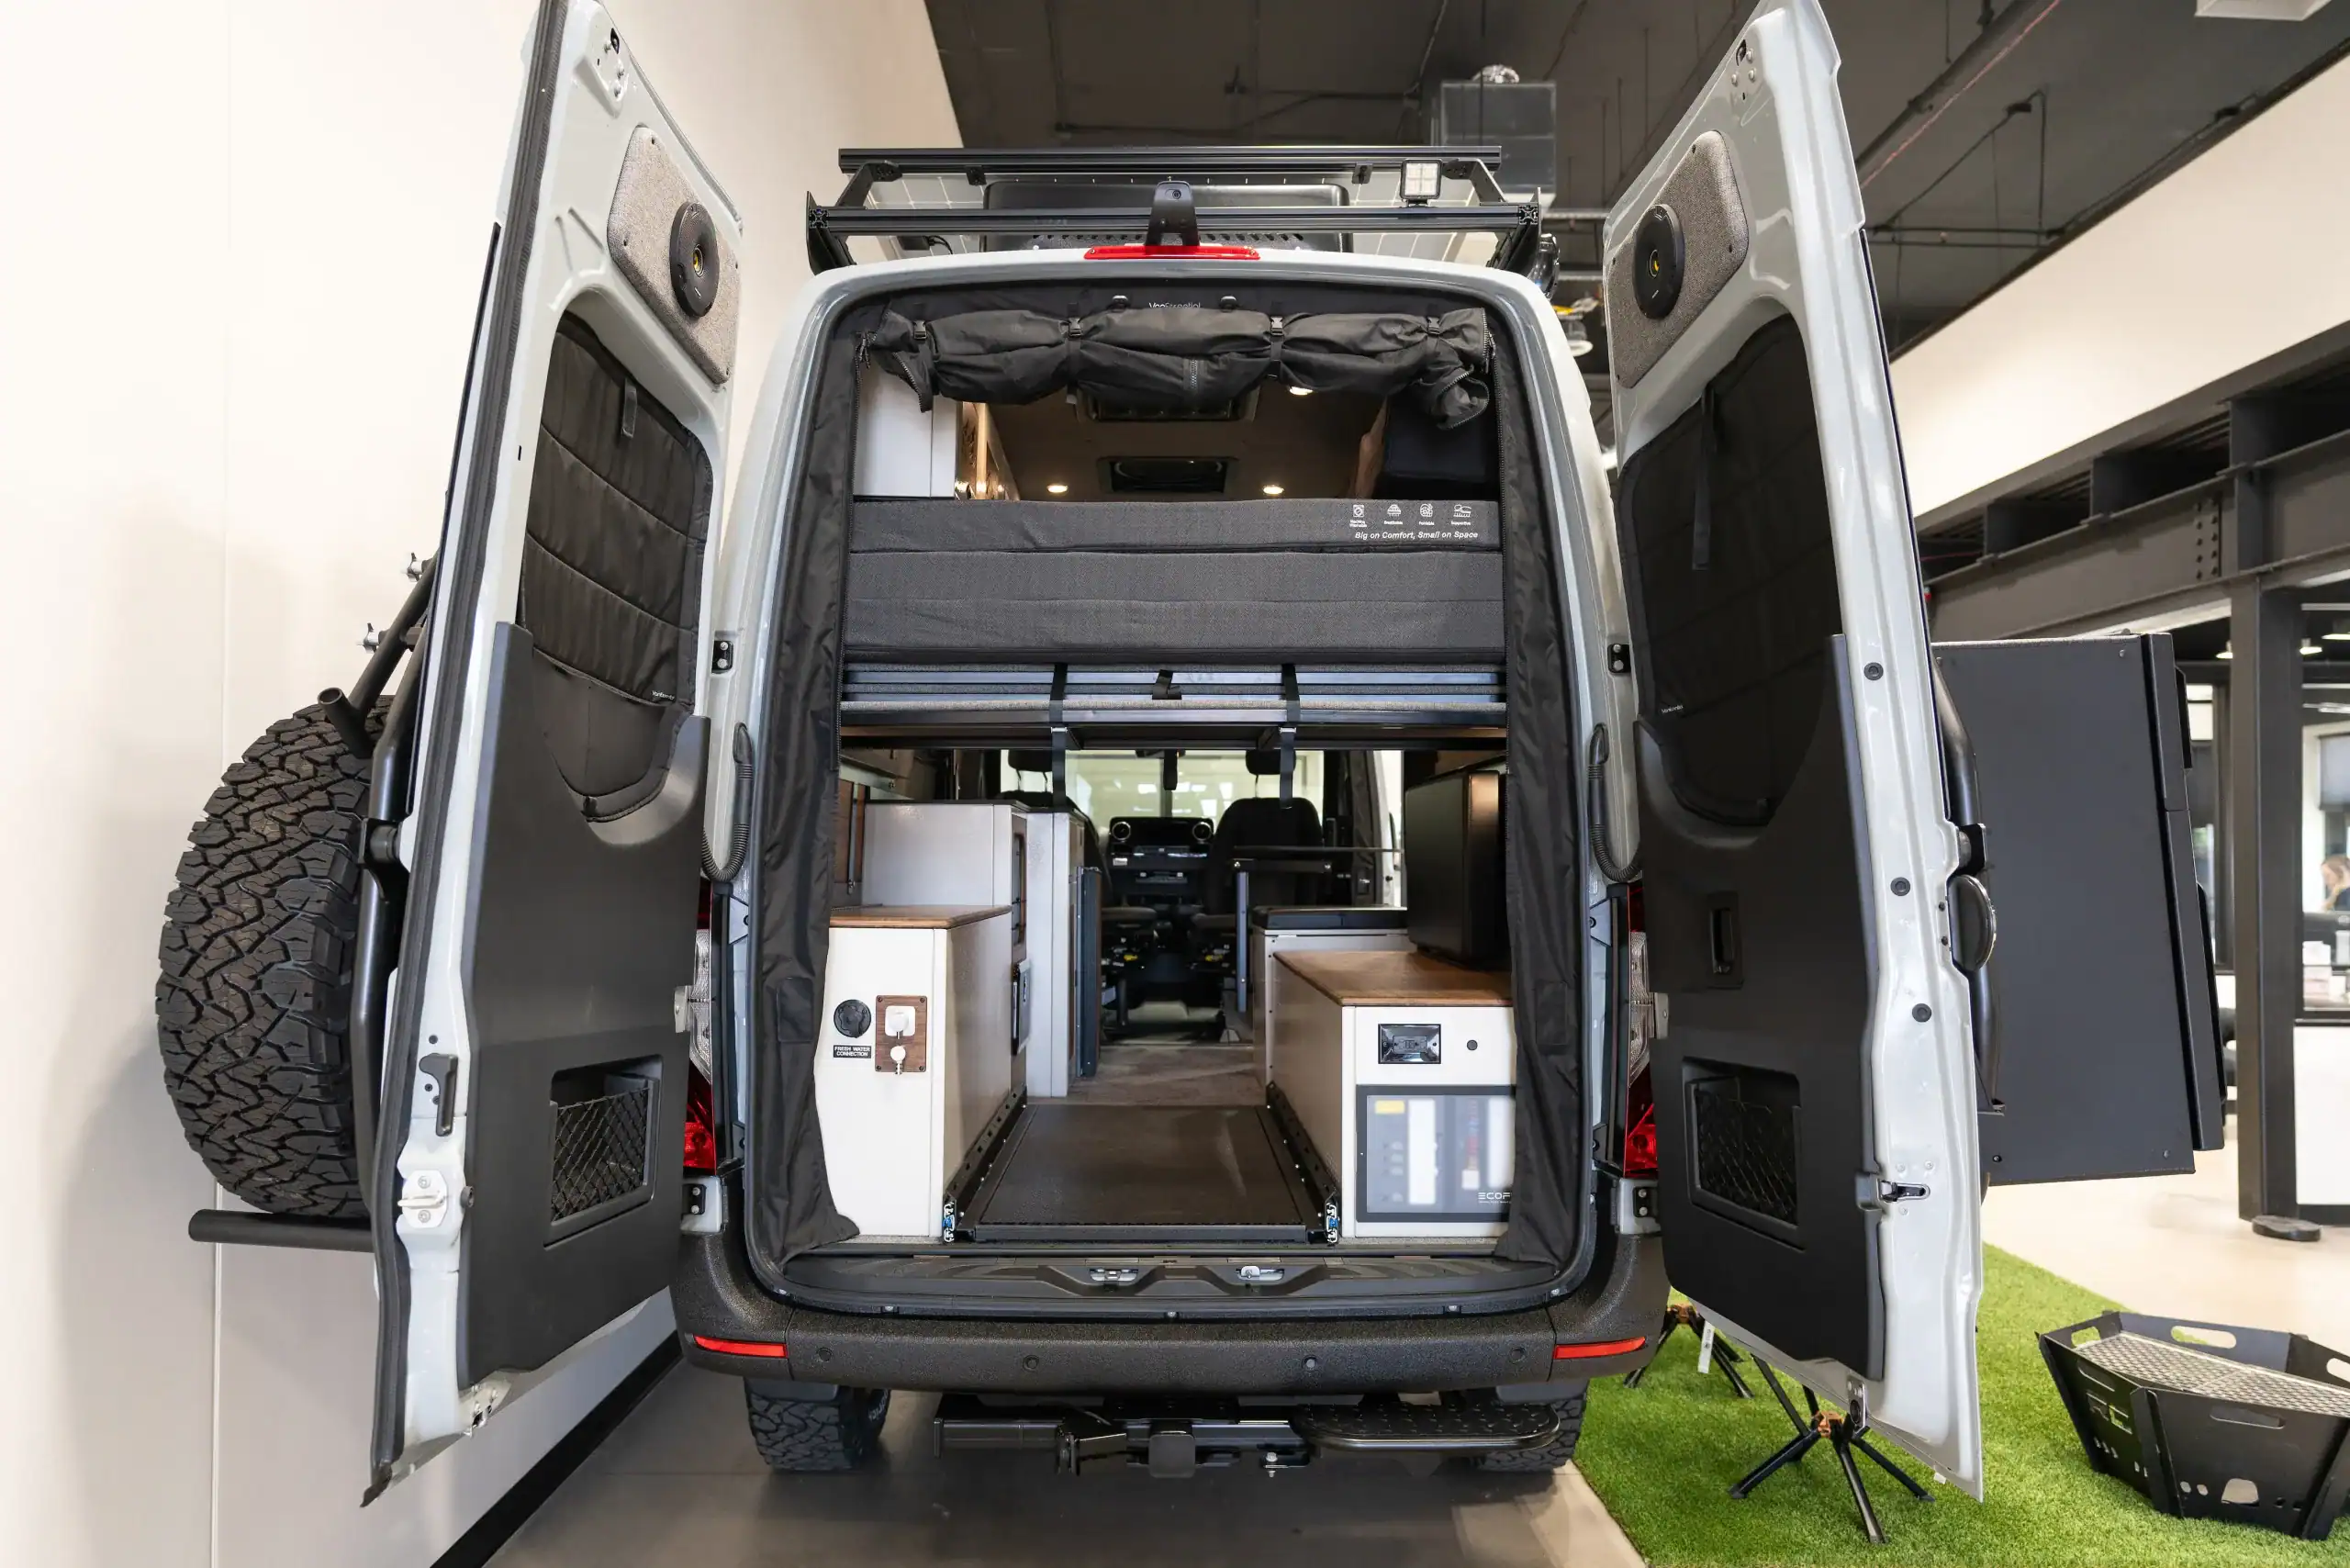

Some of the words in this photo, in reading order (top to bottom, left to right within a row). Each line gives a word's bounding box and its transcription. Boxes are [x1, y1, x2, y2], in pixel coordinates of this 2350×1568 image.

[1355, 532, 1368, 540] Big
[1382, 532, 1416, 540] Comfort,
[1417, 531, 1440, 539] Small
